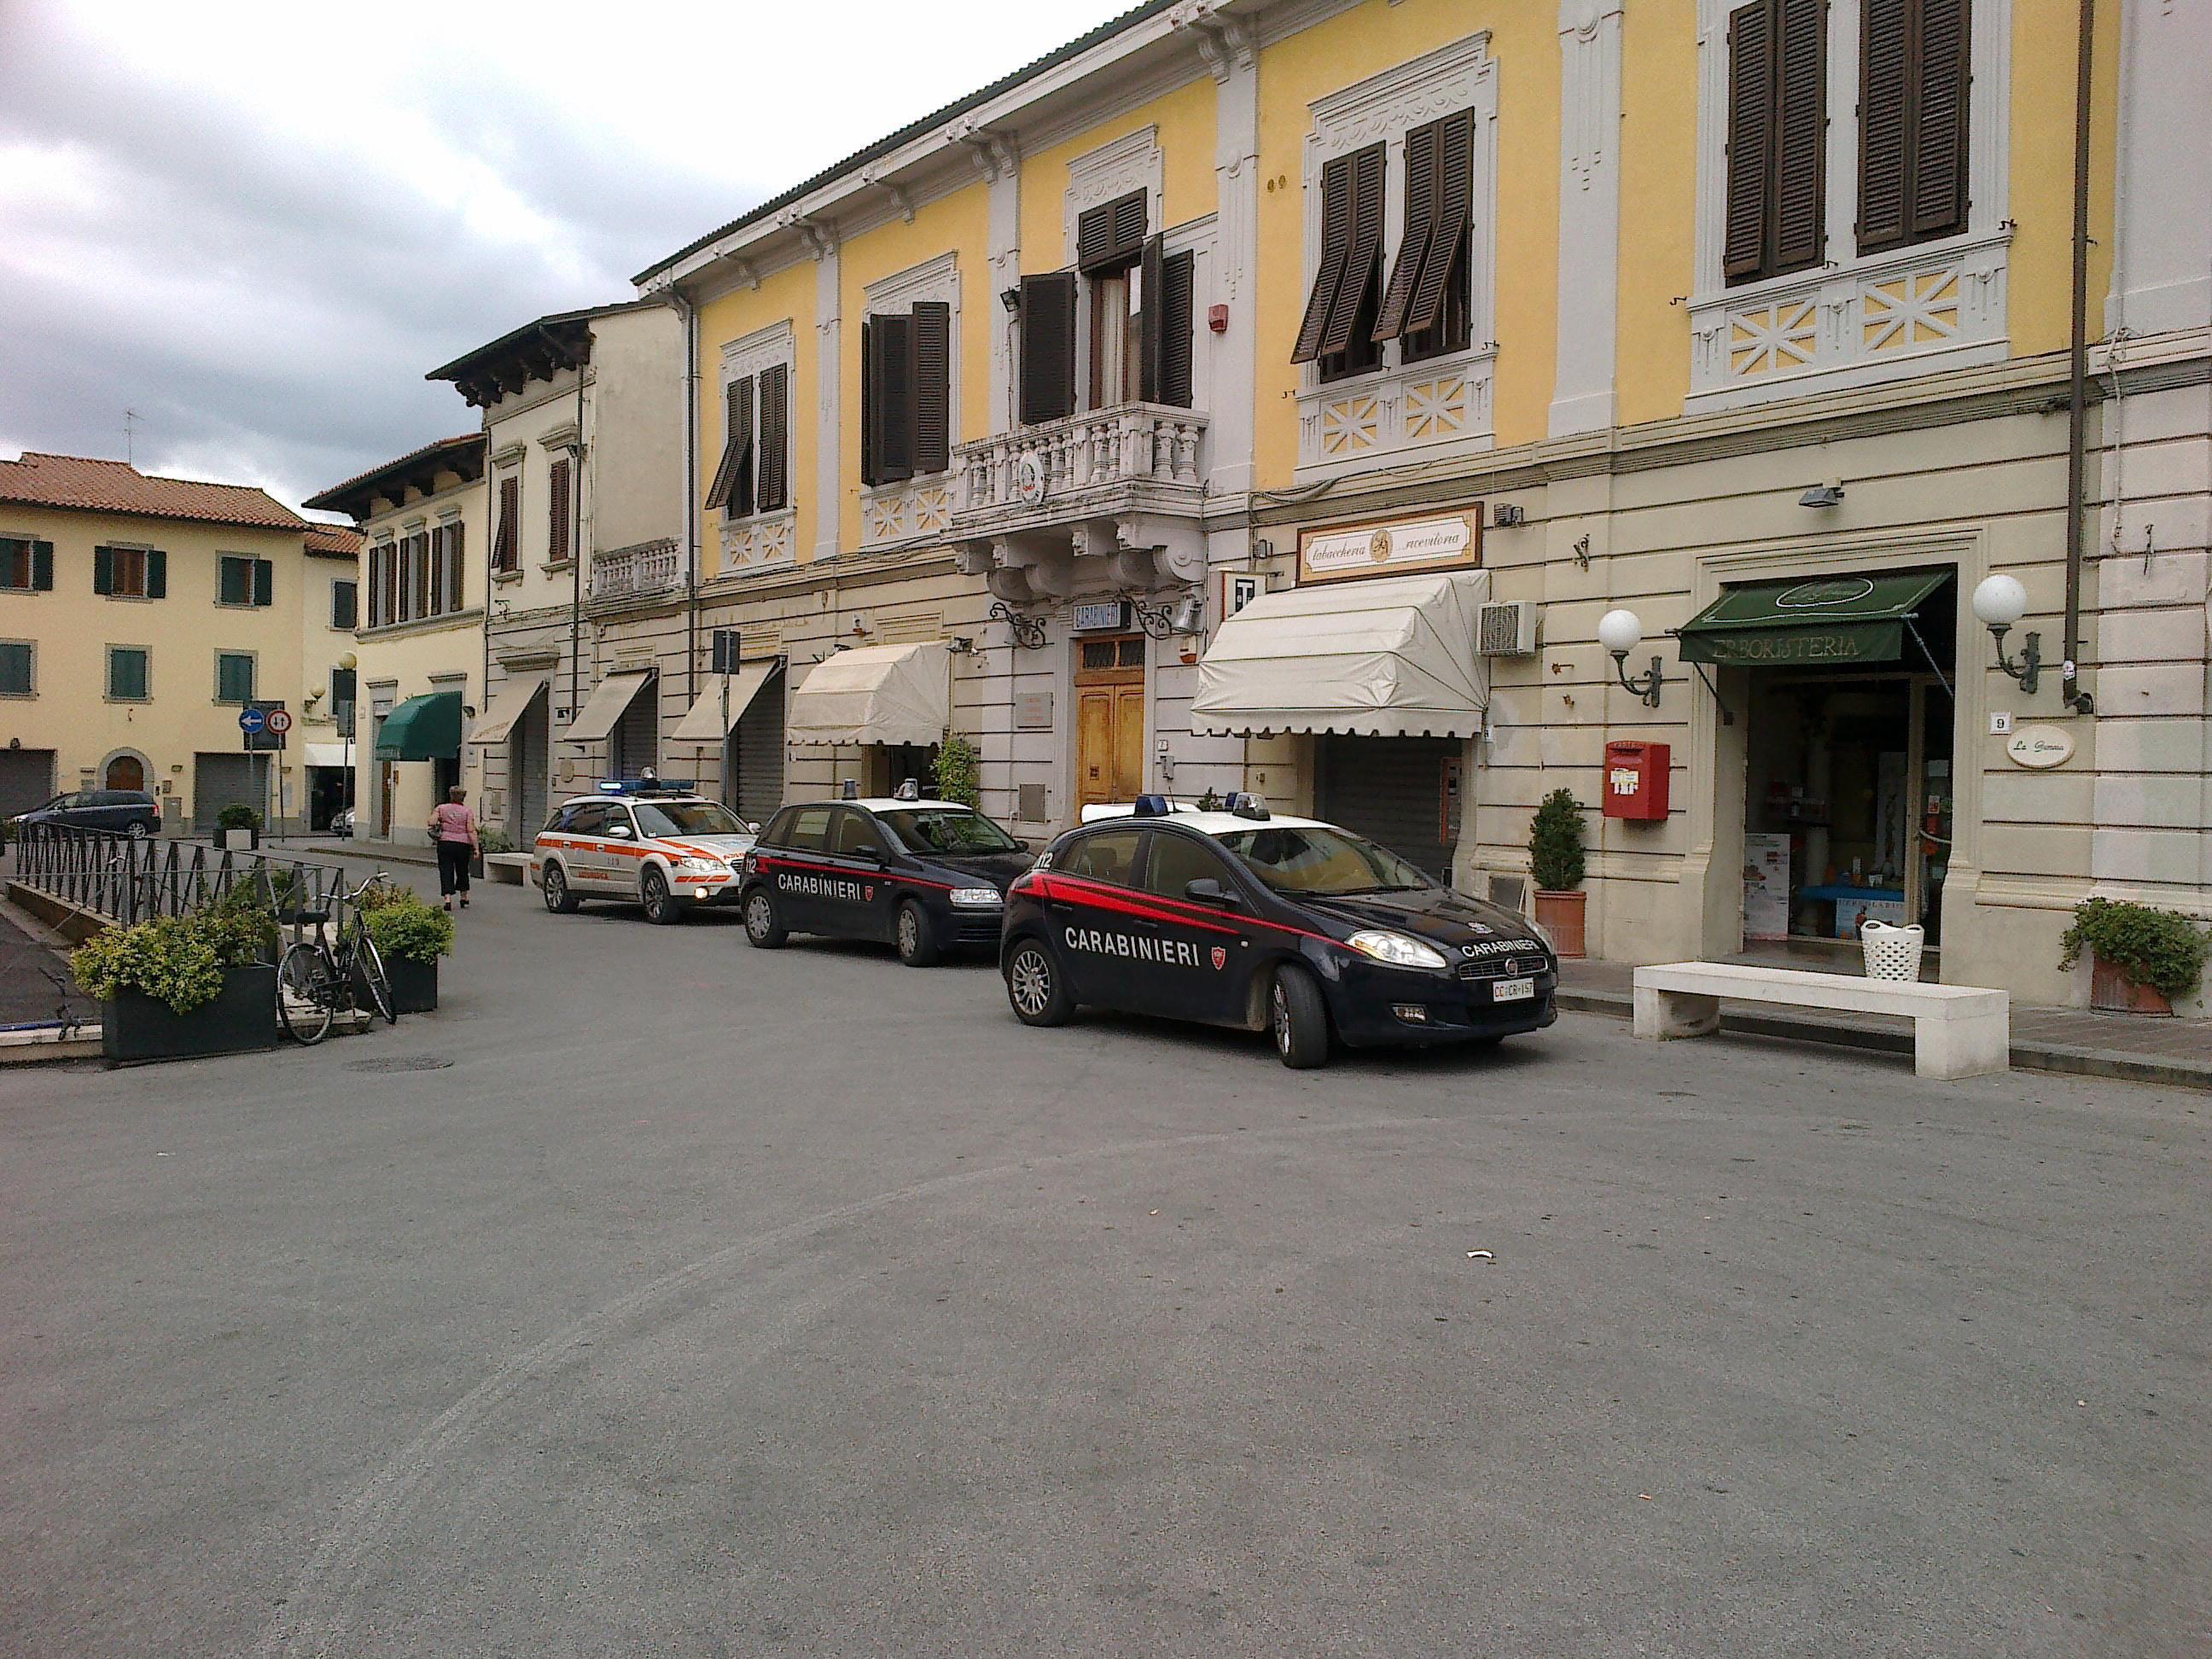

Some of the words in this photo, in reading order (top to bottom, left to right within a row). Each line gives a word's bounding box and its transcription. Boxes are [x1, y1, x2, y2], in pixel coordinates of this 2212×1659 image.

[1312, 540, 1365, 562] tabaccheria
[1076, 604, 1118, 627] CARABINIERI
[1712, 636, 1859, 659] ERBORISTERIA
[1997, 719, 2005, 729] 9
[745, 858, 757, 874] 112
[777, 873, 861, 900] CARABINIERI
[1065, 927, 1200, 966] CARABINIERI
